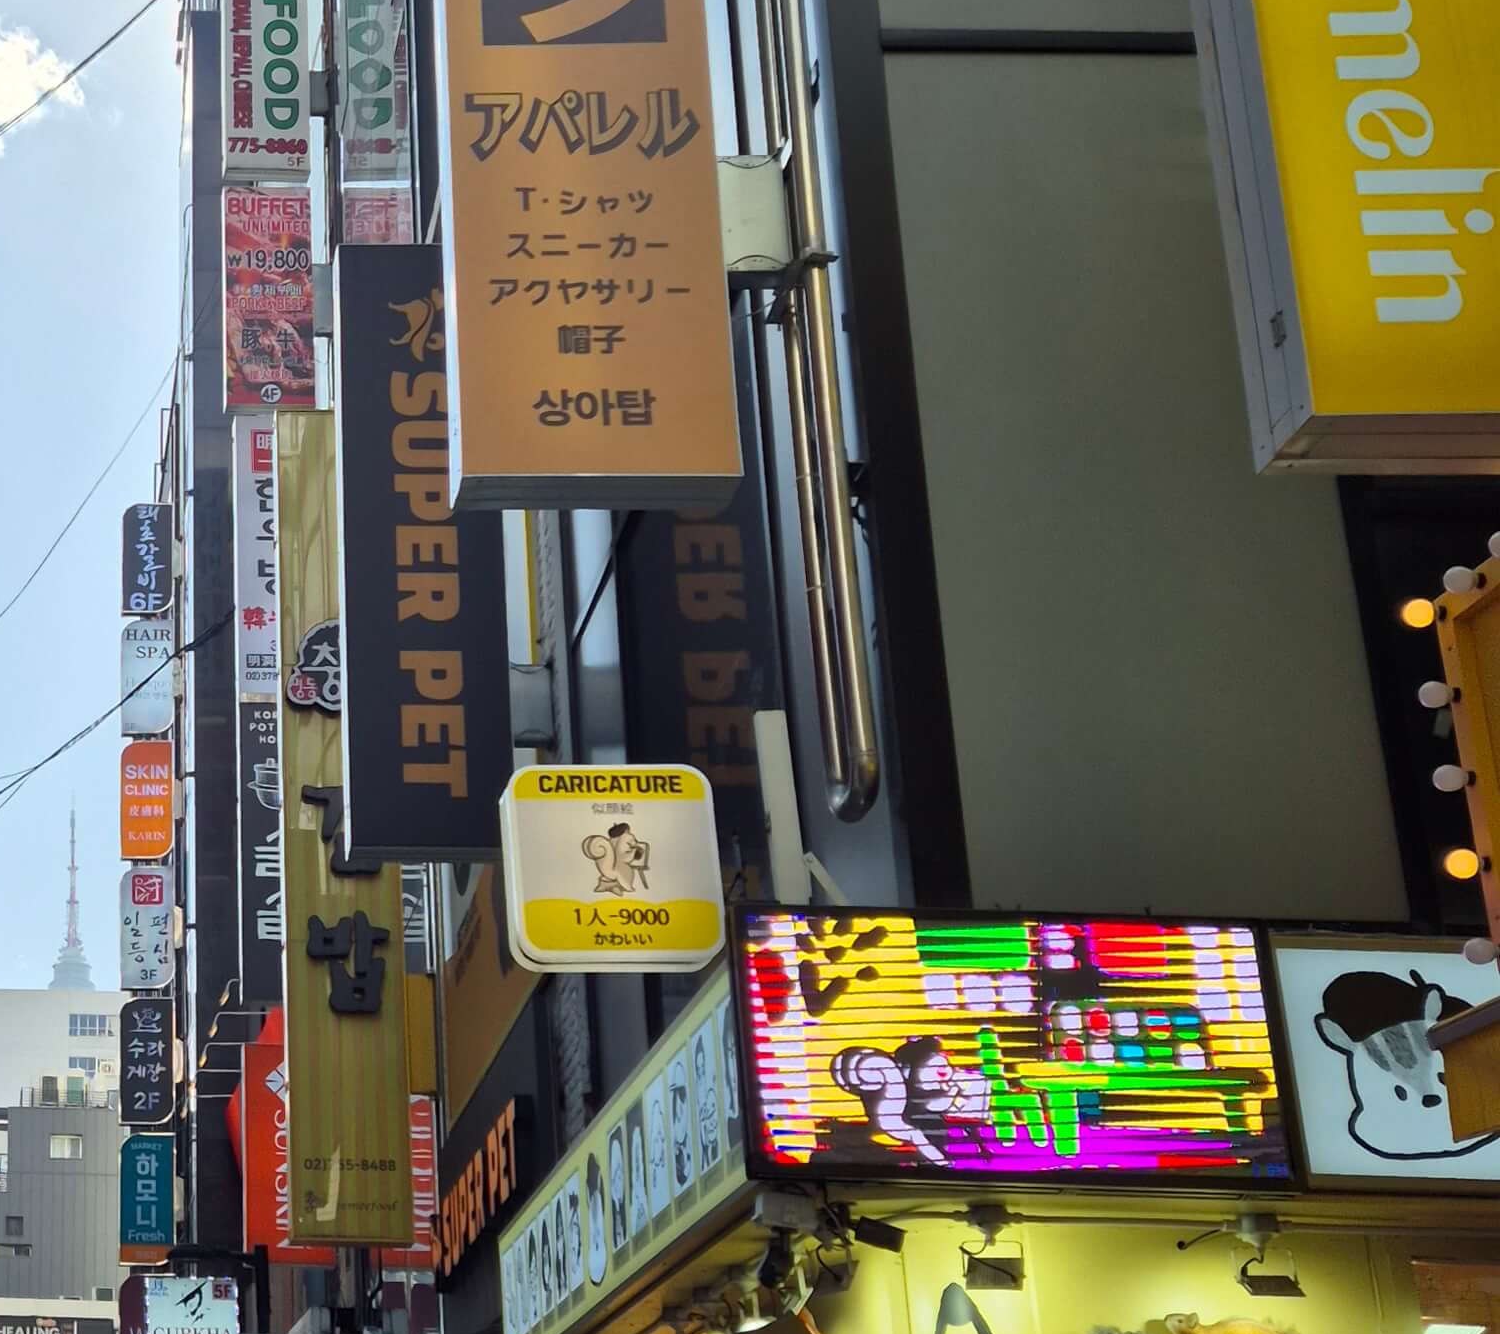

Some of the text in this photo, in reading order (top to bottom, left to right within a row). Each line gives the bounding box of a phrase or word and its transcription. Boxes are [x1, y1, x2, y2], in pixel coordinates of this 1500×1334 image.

[463, 88, 700, 163] アパレル
[287, 156, 306, 167] 5F
[226, 196, 311, 217] BUFFET
[242, 219, 310, 234] UNLIMITED
[506, 232, 669, 260] スニーカー
[556, 324, 627, 356] 帽子
[262, 385, 282, 402] 4F
[532, 387, 657, 427] 상아탑
[390, 370, 469, 800] SUPER PET
[129, 592, 164, 611] 6F
[126, 628, 172, 641] HAIR
[135, 646, 172, 659] SPA
[125, 765, 169, 780] SKIN
[125, 783, 169, 796] CLINIC
[538, 775, 683, 795] CARICATURE
[594, 931, 653, 947] かわいい
[140, 968, 157, 980] 3F
[133, 1091, 161, 1111] 2F
[135, 1153, 159, 1228] 하모니
[441, 1097, 517, 1278] SUPER PET
[128, 1228, 166, 1243] Fresh
[213, 1284, 232, 1300] 5F
